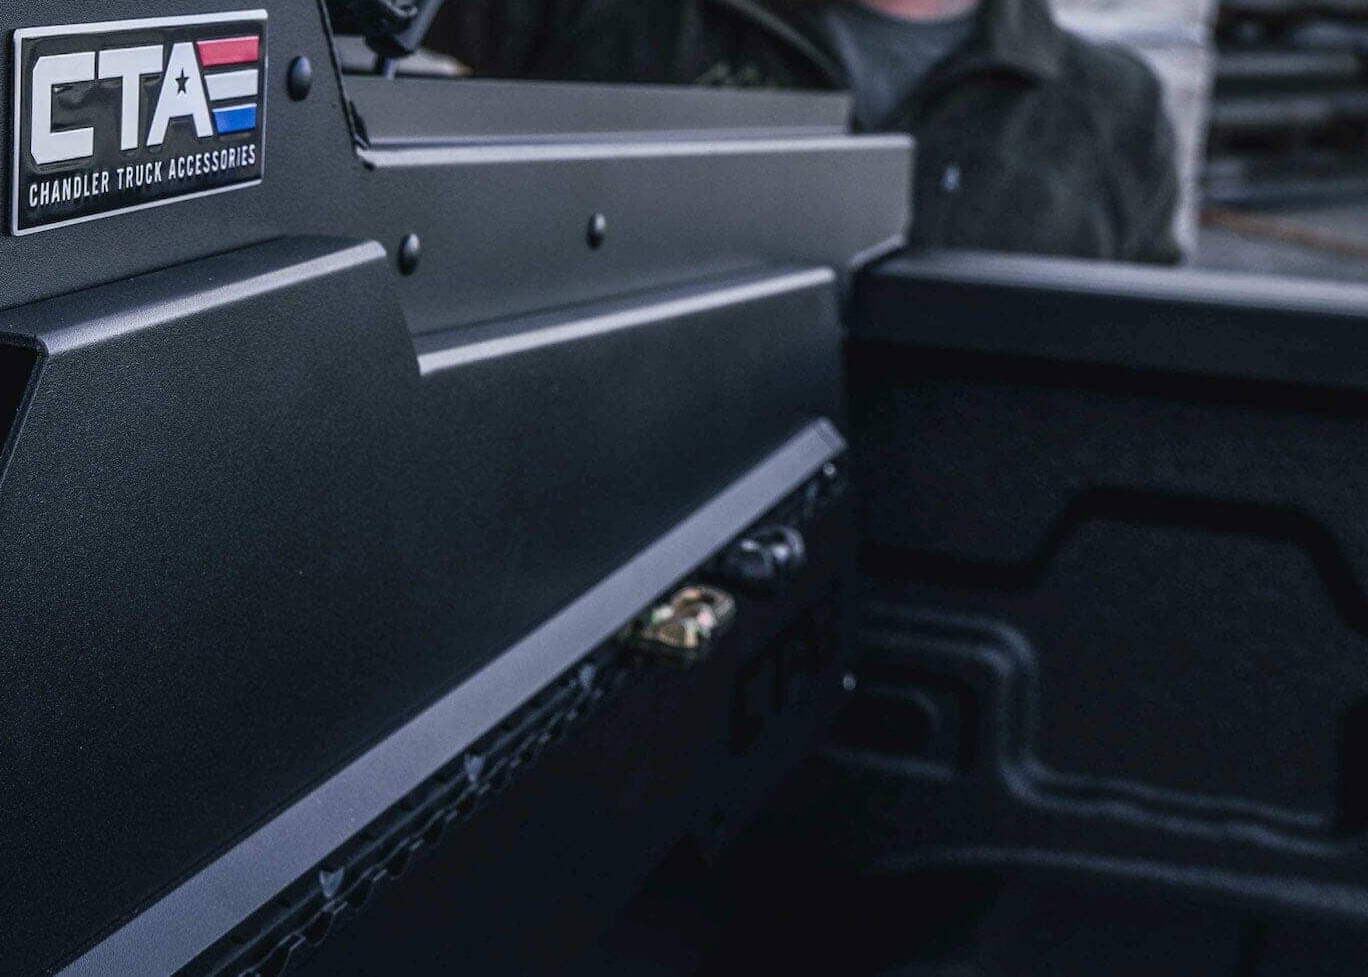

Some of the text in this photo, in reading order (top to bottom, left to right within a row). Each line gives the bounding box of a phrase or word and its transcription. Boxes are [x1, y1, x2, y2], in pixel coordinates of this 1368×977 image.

[31, 41, 214, 165] CTA
[29, 144, 256, 208] CHANDLER TRUCK ACCESSORIES
